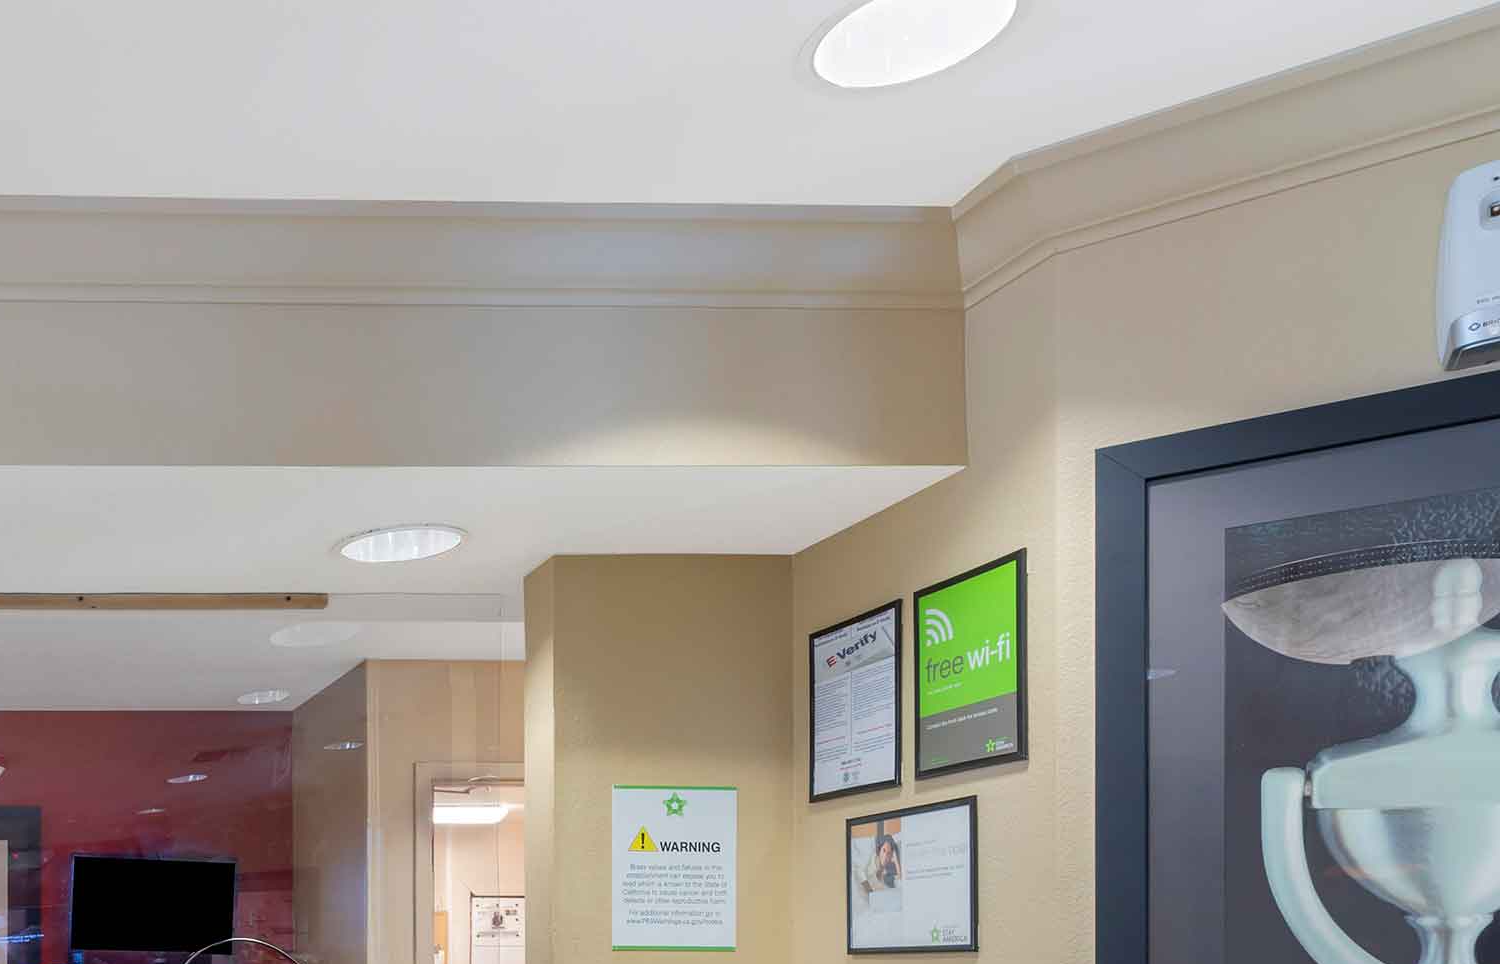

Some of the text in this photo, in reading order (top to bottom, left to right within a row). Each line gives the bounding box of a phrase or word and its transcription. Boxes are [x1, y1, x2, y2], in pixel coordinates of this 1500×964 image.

[925, 631, 1011, 684] free wi-fi
[659, 841, 721, 853] WARNING
